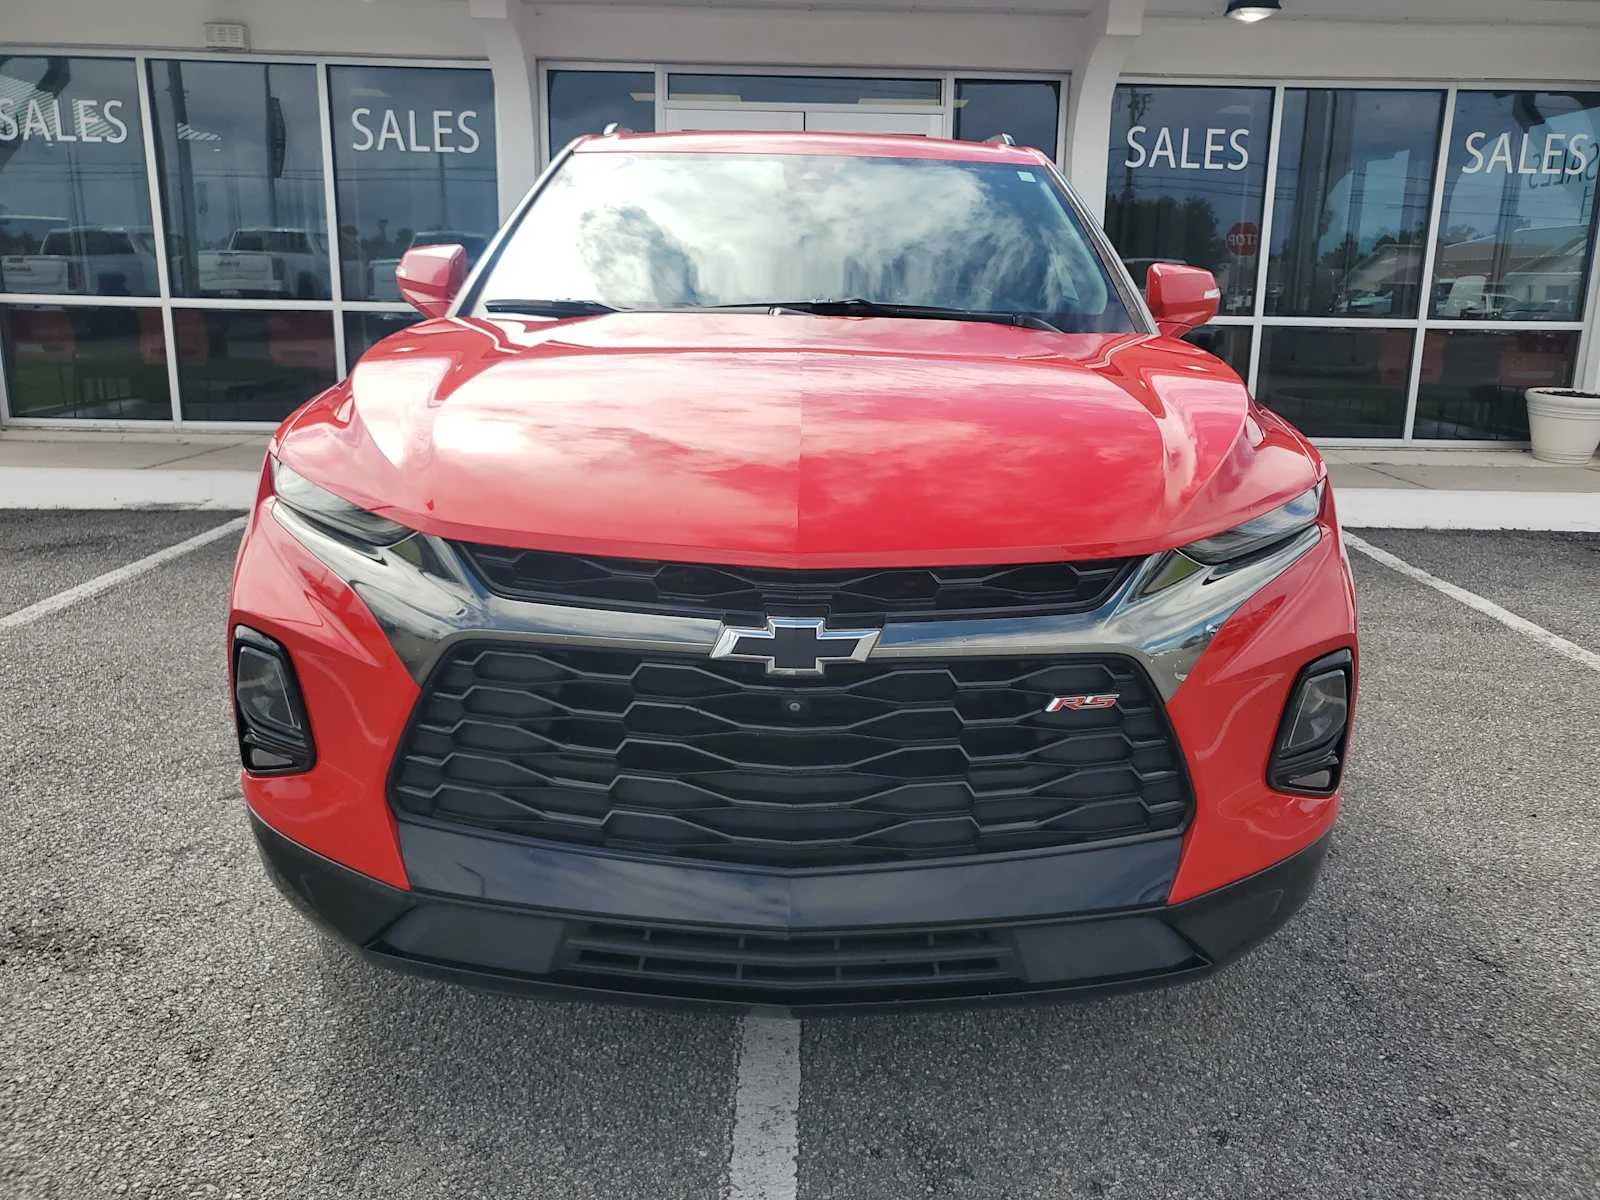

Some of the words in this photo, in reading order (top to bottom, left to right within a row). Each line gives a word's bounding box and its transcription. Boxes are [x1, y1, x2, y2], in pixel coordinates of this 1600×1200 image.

[0, 98, 128, 143] SALES
[351, 107, 480, 153] SALES
[1124, 126, 1250, 170] SALES
[1462, 131, 1589, 175] SALES
[1045, 694, 1120, 712] RS
